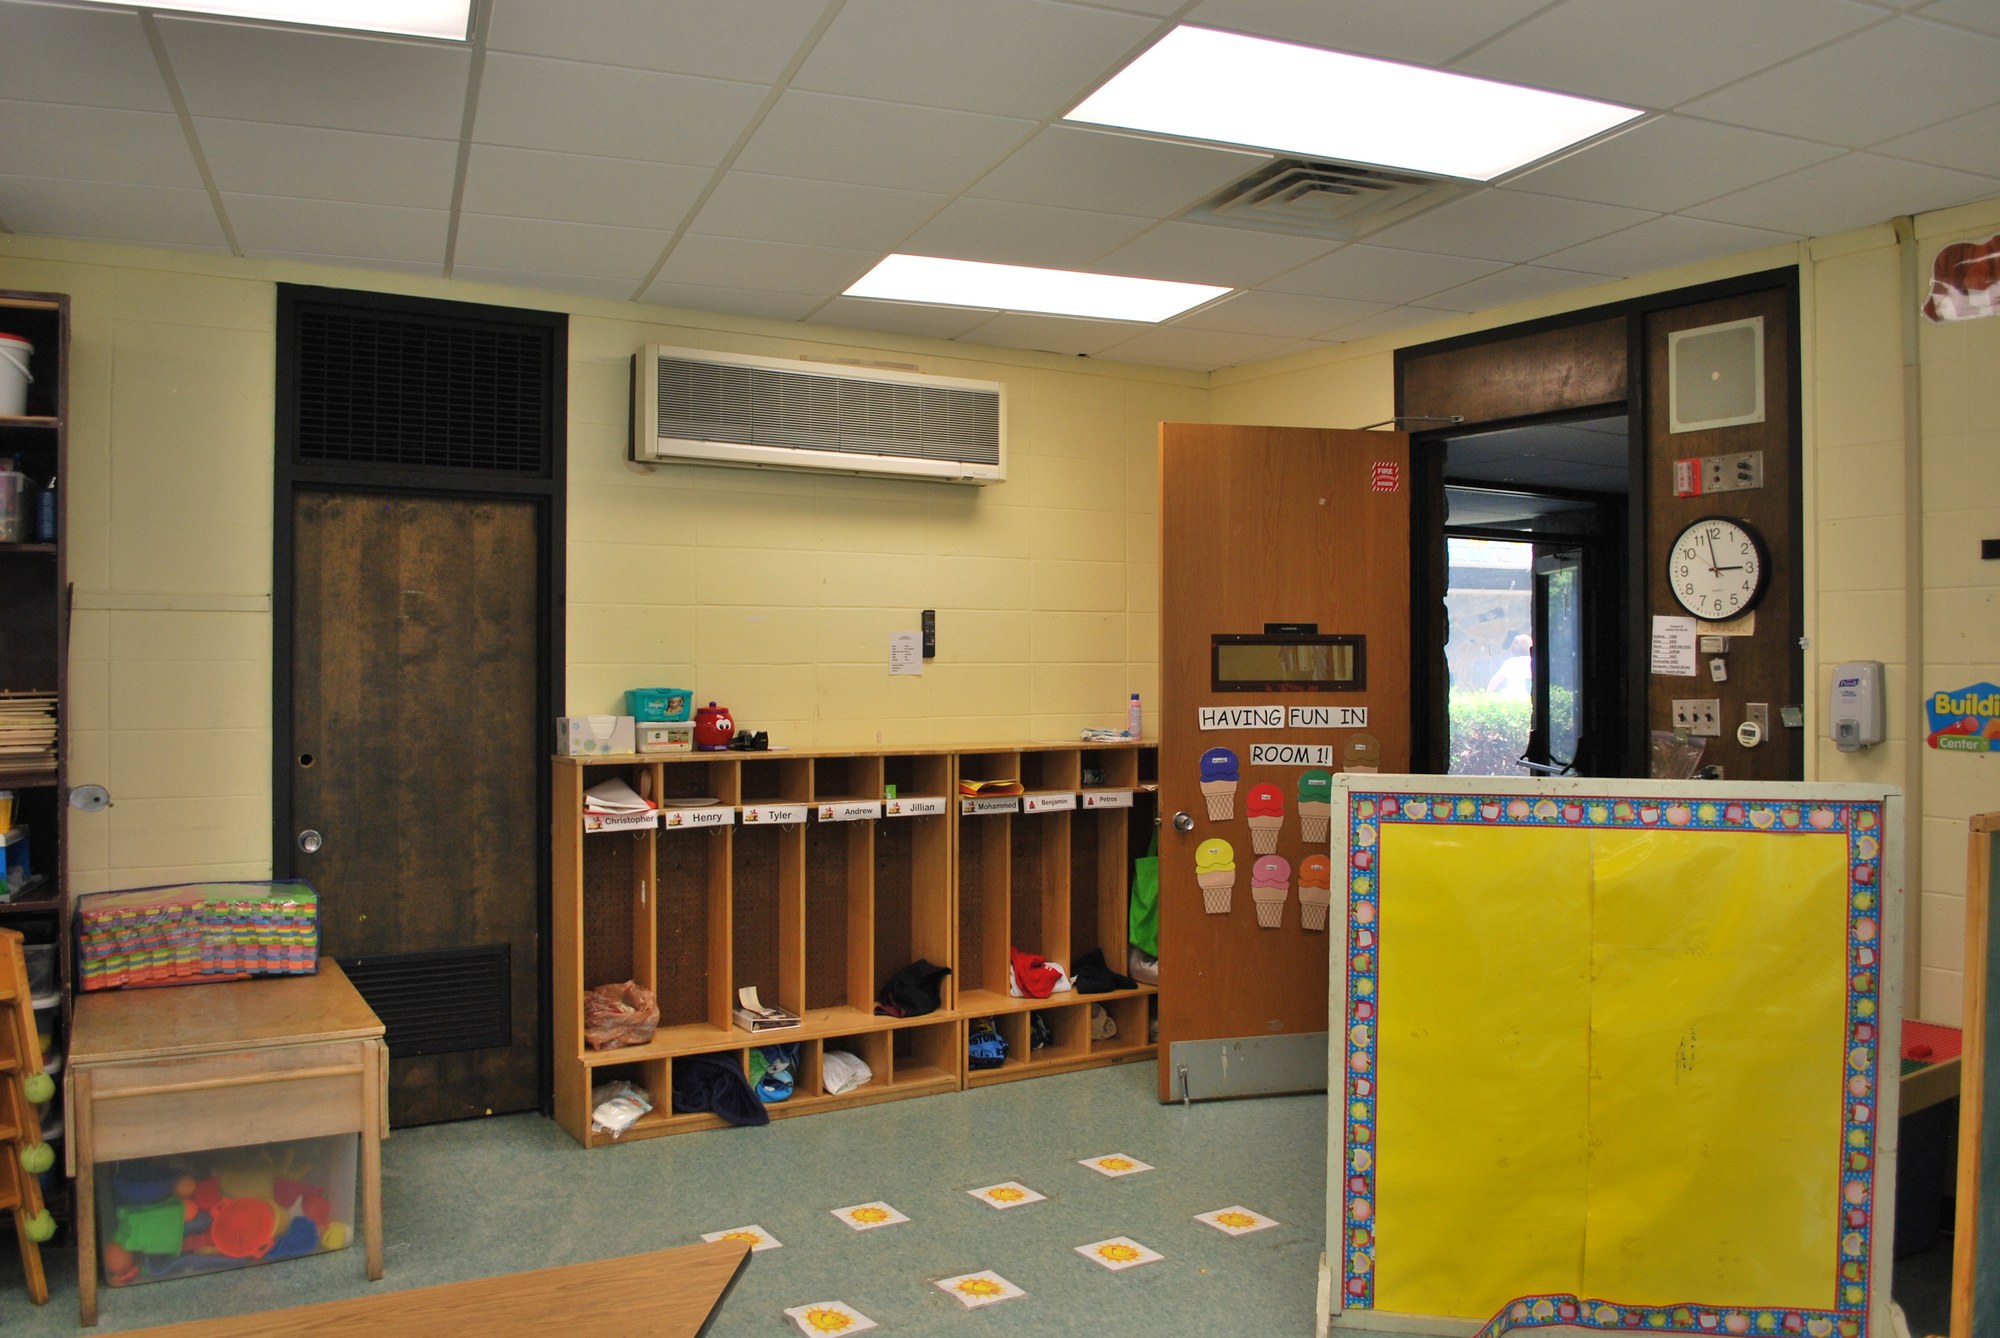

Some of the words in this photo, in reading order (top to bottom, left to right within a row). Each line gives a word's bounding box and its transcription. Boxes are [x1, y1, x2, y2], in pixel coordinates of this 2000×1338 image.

[1709, 527, 1720, 540] 12
[1729, 531, 1734, 543] 1
[1694, 535, 1704, 546] 11
[1683, 548, 1696, 560] 10
[1741, 543, 1749, 555] 2
[1680, 565, 1689, 577] 9
[1745, 561, 1754, 574] 3
[1685, 583, 1694, 595] 8
[1741, 580, 1750, 592] 4
[1699, 595, 1707, 607] 7
[1714, 599, 1722, 611] 6
[1730, 593, 1739, 605] 5
[1202, 709, 1281, 727] HAVING
[1290, 708, 1329, 726] FUN
[1340, 708, 1366, 725] IN
[1939, 737, 1979, 749] Center
[1252, 745, 1309, 763] ROOM
[1316, 747, 1329, 764] 1!
[1041, 798, 1068, 808] Benjamin
[1099, 795, 1118, 803] Petros
[844, 807, 873, 816] Andrew
[909, 803, 935, 813] Jillian
[977, 801, 1017, 811] Mohammed
[604, 814, 655, 826] Christopher
[692, 812, 722, 823] Henry
[768, 810, 792, 821] Tyler
